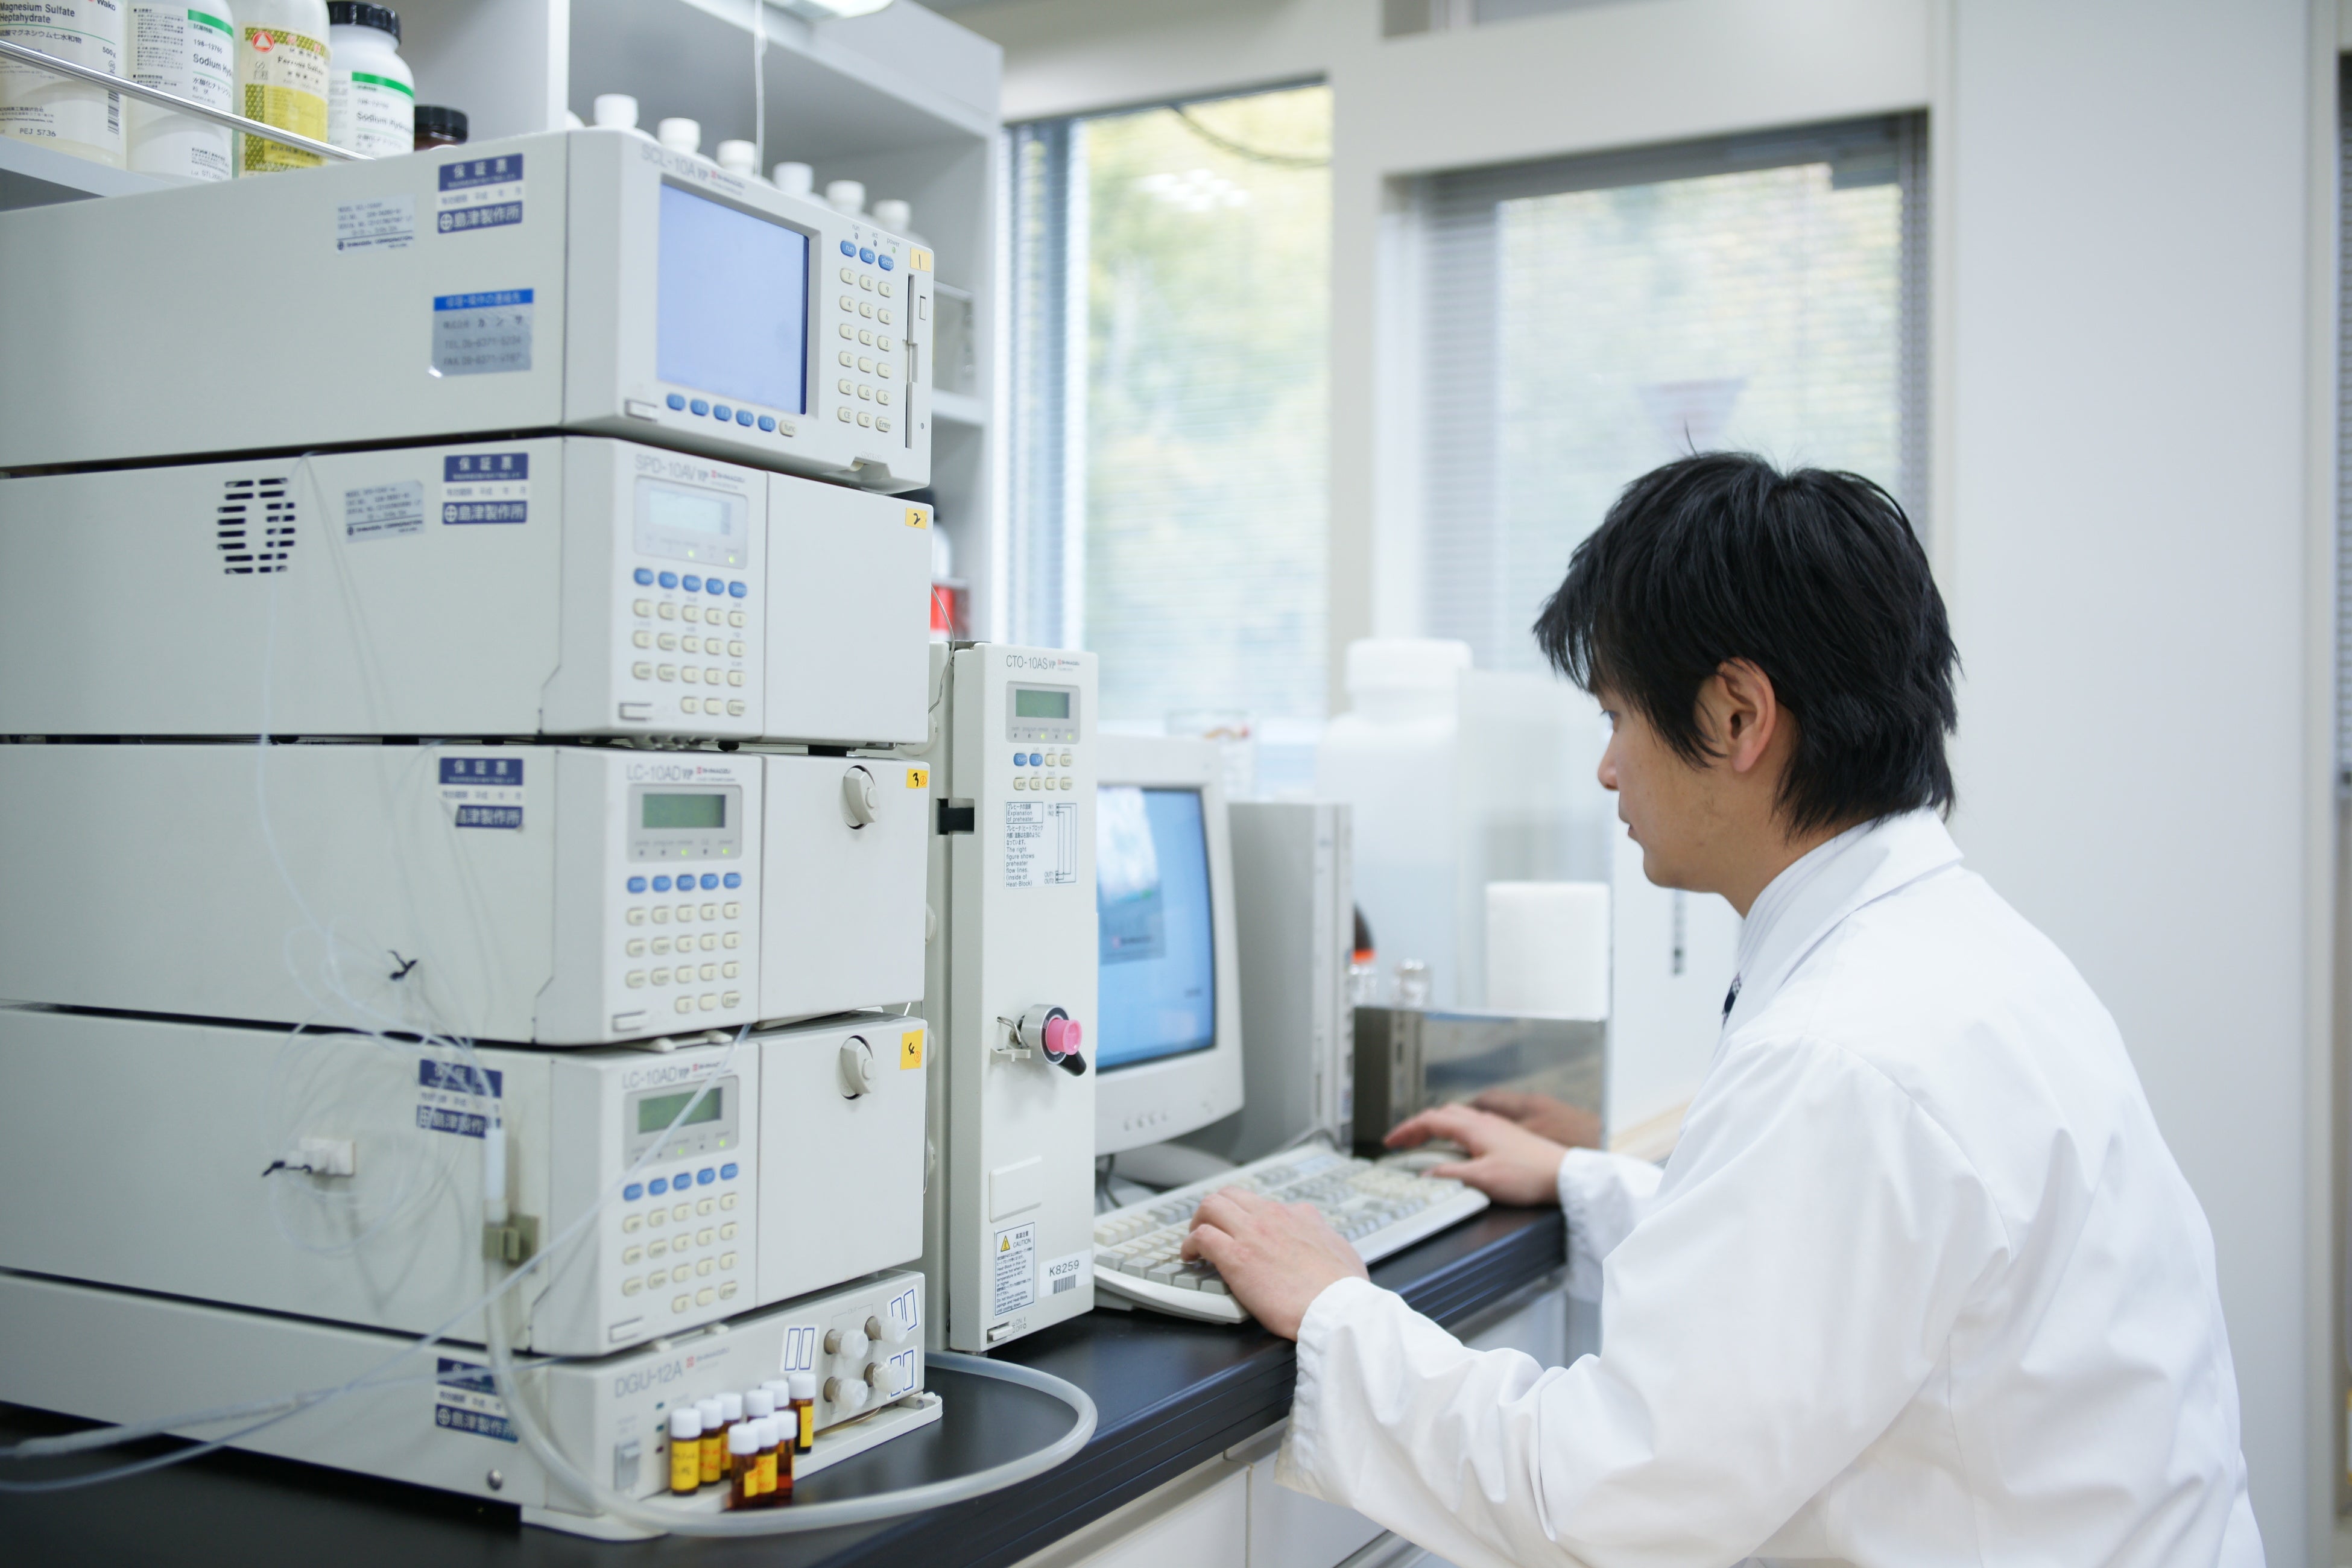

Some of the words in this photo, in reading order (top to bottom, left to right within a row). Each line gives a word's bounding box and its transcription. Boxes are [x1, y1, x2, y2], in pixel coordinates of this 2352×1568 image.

[45, 4, 75, 17] Sulfate
[96, 0, 116, 11] Wako
[0, 13, 51, 24] Heptahydrate
[193, 53, 221, 71] Sodium
[37, 128, 57, 138] 5736
[846, 245, 855, 253] run
[879, 420, 891, 429] Enter
[1013, 1238, 1031, 1248] CAUTION
[1049, 1259, 1080, 1277] K8259
[615, 1361, 683, 1399] DGU-12A
